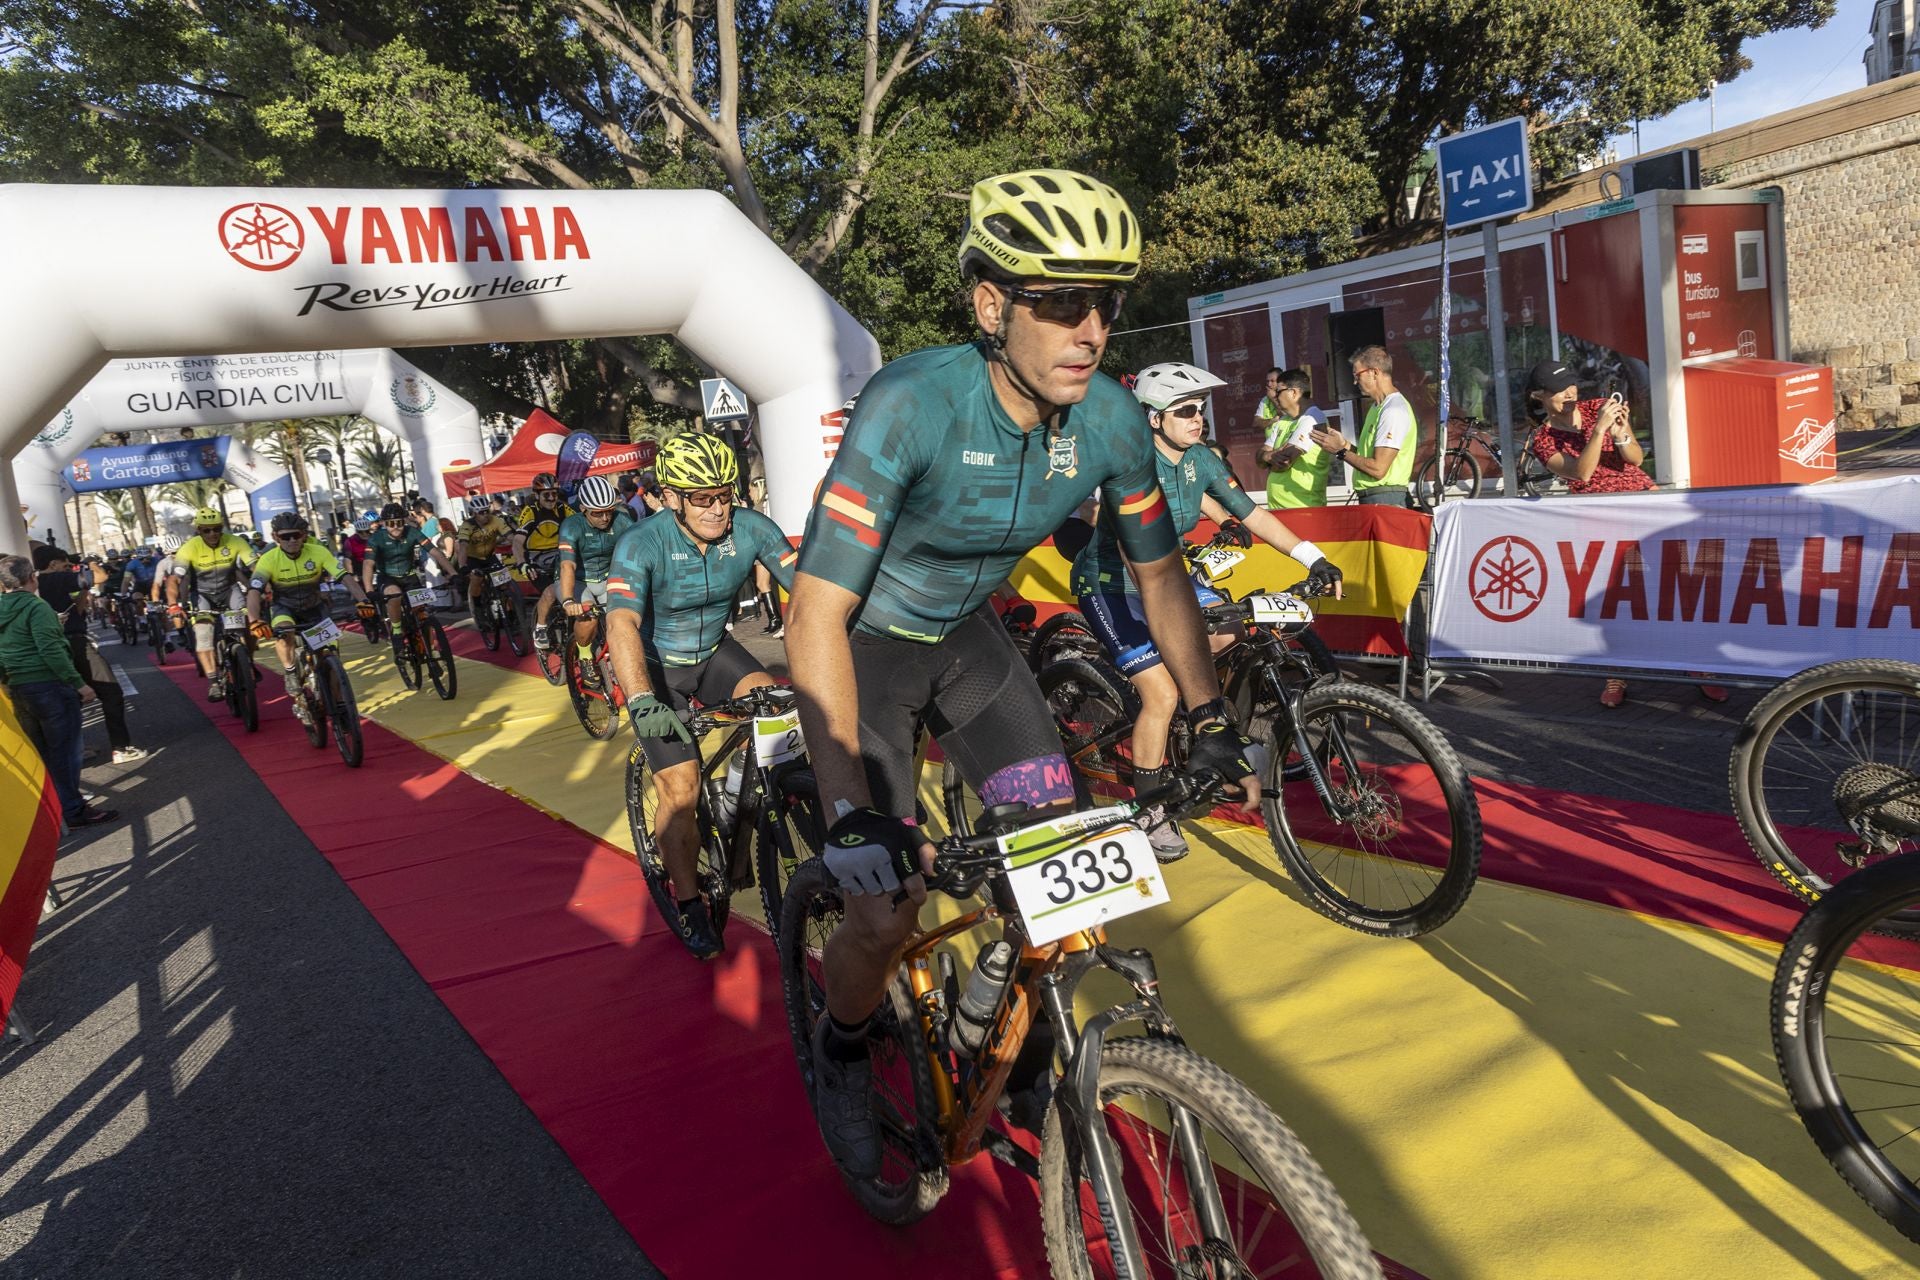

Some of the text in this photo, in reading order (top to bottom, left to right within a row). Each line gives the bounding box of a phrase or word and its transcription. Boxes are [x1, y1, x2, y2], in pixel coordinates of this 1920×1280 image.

[1446, 154, 1521, 194] TAXI
[306, 206, 591, 265] YAMAHA
[970, 225, 1020, 266] SPECIALIZED
[1684, 270, 1703, 285] bus
[293, 273, 568, 317] Revs Your Heart
[1685, 285, 1720, 301] turístico
[124, 351, 336, 371] JUNTA CENTRAL DE EDUCACIÓN
[171, 366, 299, 383] FÍSICA Y DEPORTES
[127, 381, 344, 414] GUARDIA CIVIL
[101, 449, 189, 467] Ayuntamiento
[102, 461, 191, 481] Cartagena
[962, 450, 996, 467] GOBIK
[1556, 531, 1920, 630] YAMAHA
[1262, 596, 1299, 611] 164
[315, 629, 331, 643] 73
[1091, 595, 1124, 651] SALTAMONTES
[1121, 650, 1160, 671] ORIHUEL
[1043, 763, 1070, 790] M
[1040, 840, 1133, 905] 333
[1773, 862, 1822, 901] AXXIS
[1784, 943, 1818, 1037] MAXXIS
